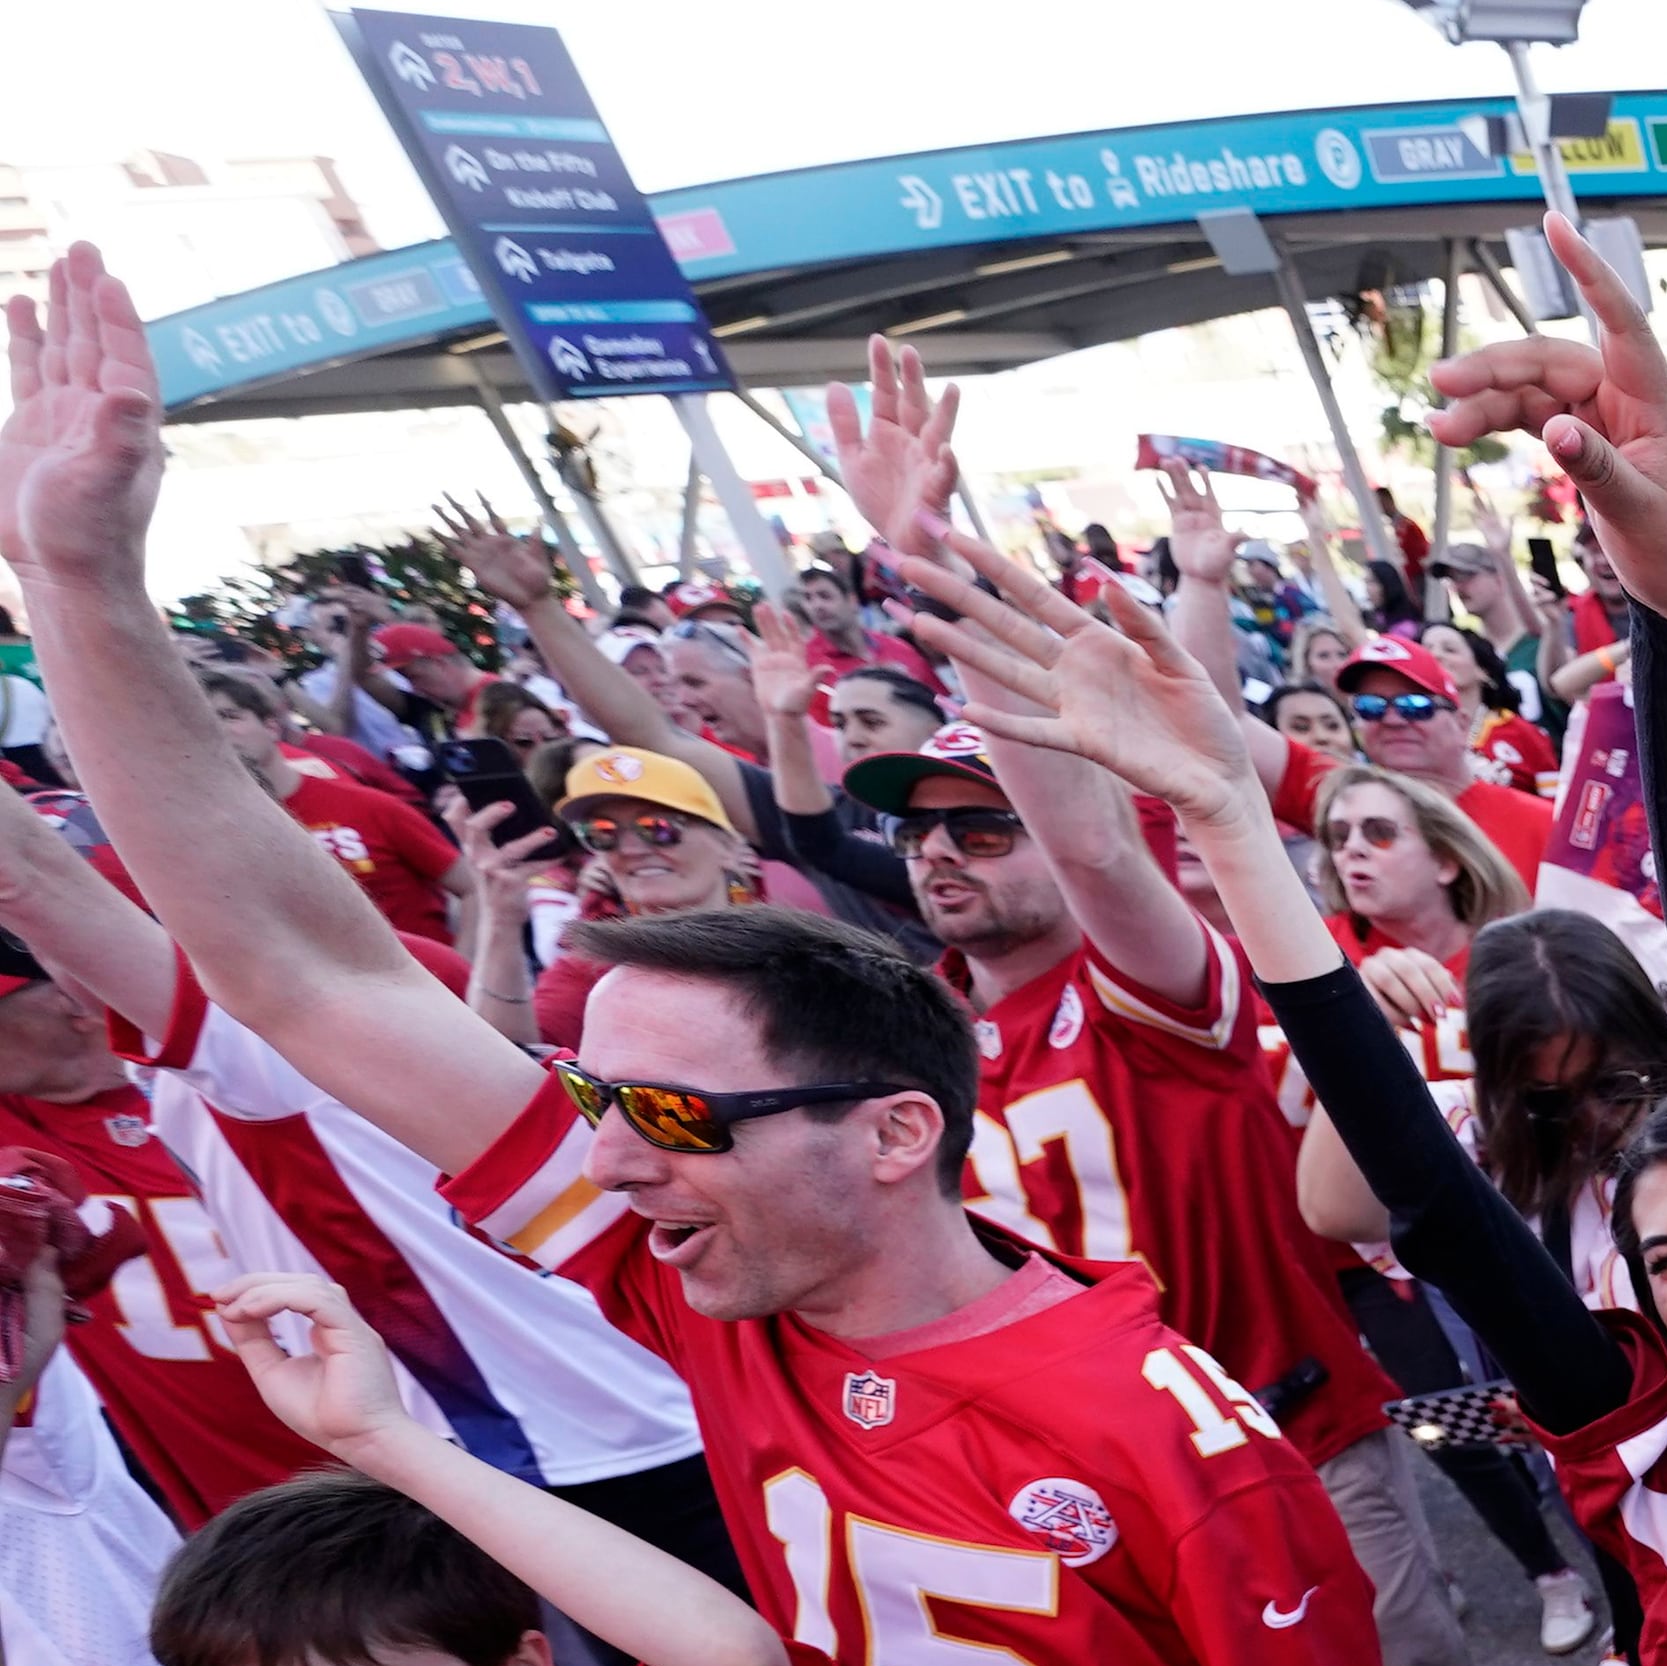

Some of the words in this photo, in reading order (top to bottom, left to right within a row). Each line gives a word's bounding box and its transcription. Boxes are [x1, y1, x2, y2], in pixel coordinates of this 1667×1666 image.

[573, 188, 619, 211] Club
[953, 168, 1039, 221] EXIT
[1047, 167, 1096, 211] to
[1140, 147, 1307, 199] Rideshare
[1397, 130, 1466, 172] GRAY
[217, 315, 286, 364] EXIT
[286, 309, 320, 346] to
[847, 1393, 895, 1424] NFL
[1140, 1342, 1284, 1460] 15
